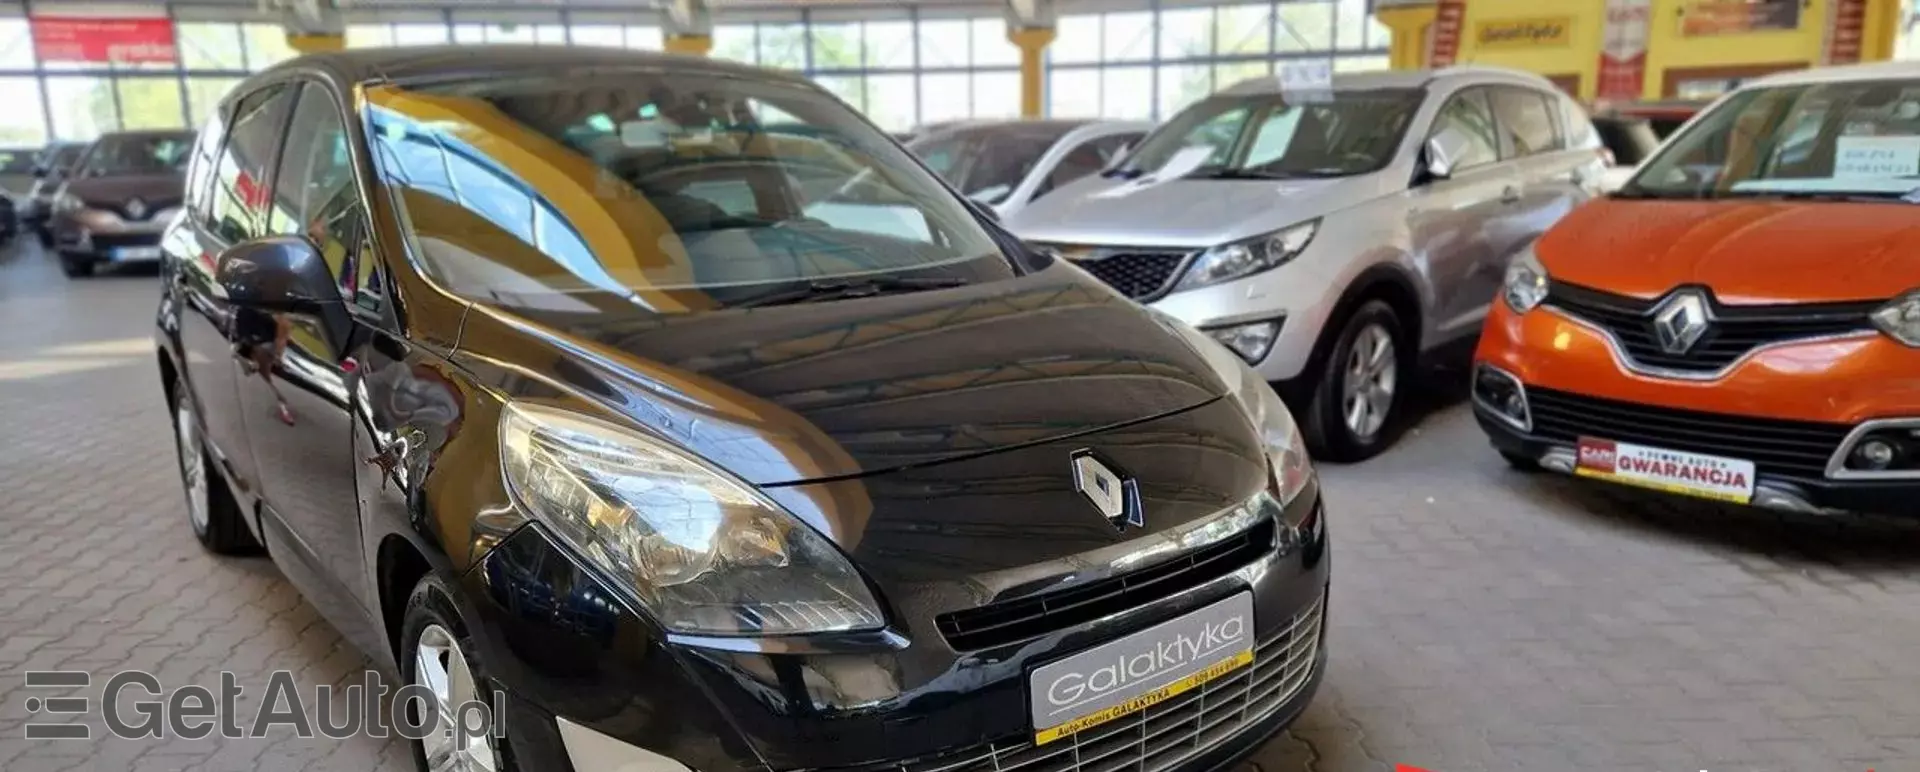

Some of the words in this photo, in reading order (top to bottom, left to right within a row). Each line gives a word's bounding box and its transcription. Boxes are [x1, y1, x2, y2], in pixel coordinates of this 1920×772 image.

[1618, 455, 1748, 489] GWARANCJA
[1048, 615, 1244, 706] Galaktyka
[1112, 687, 1171, 717] GALAKTYKA
